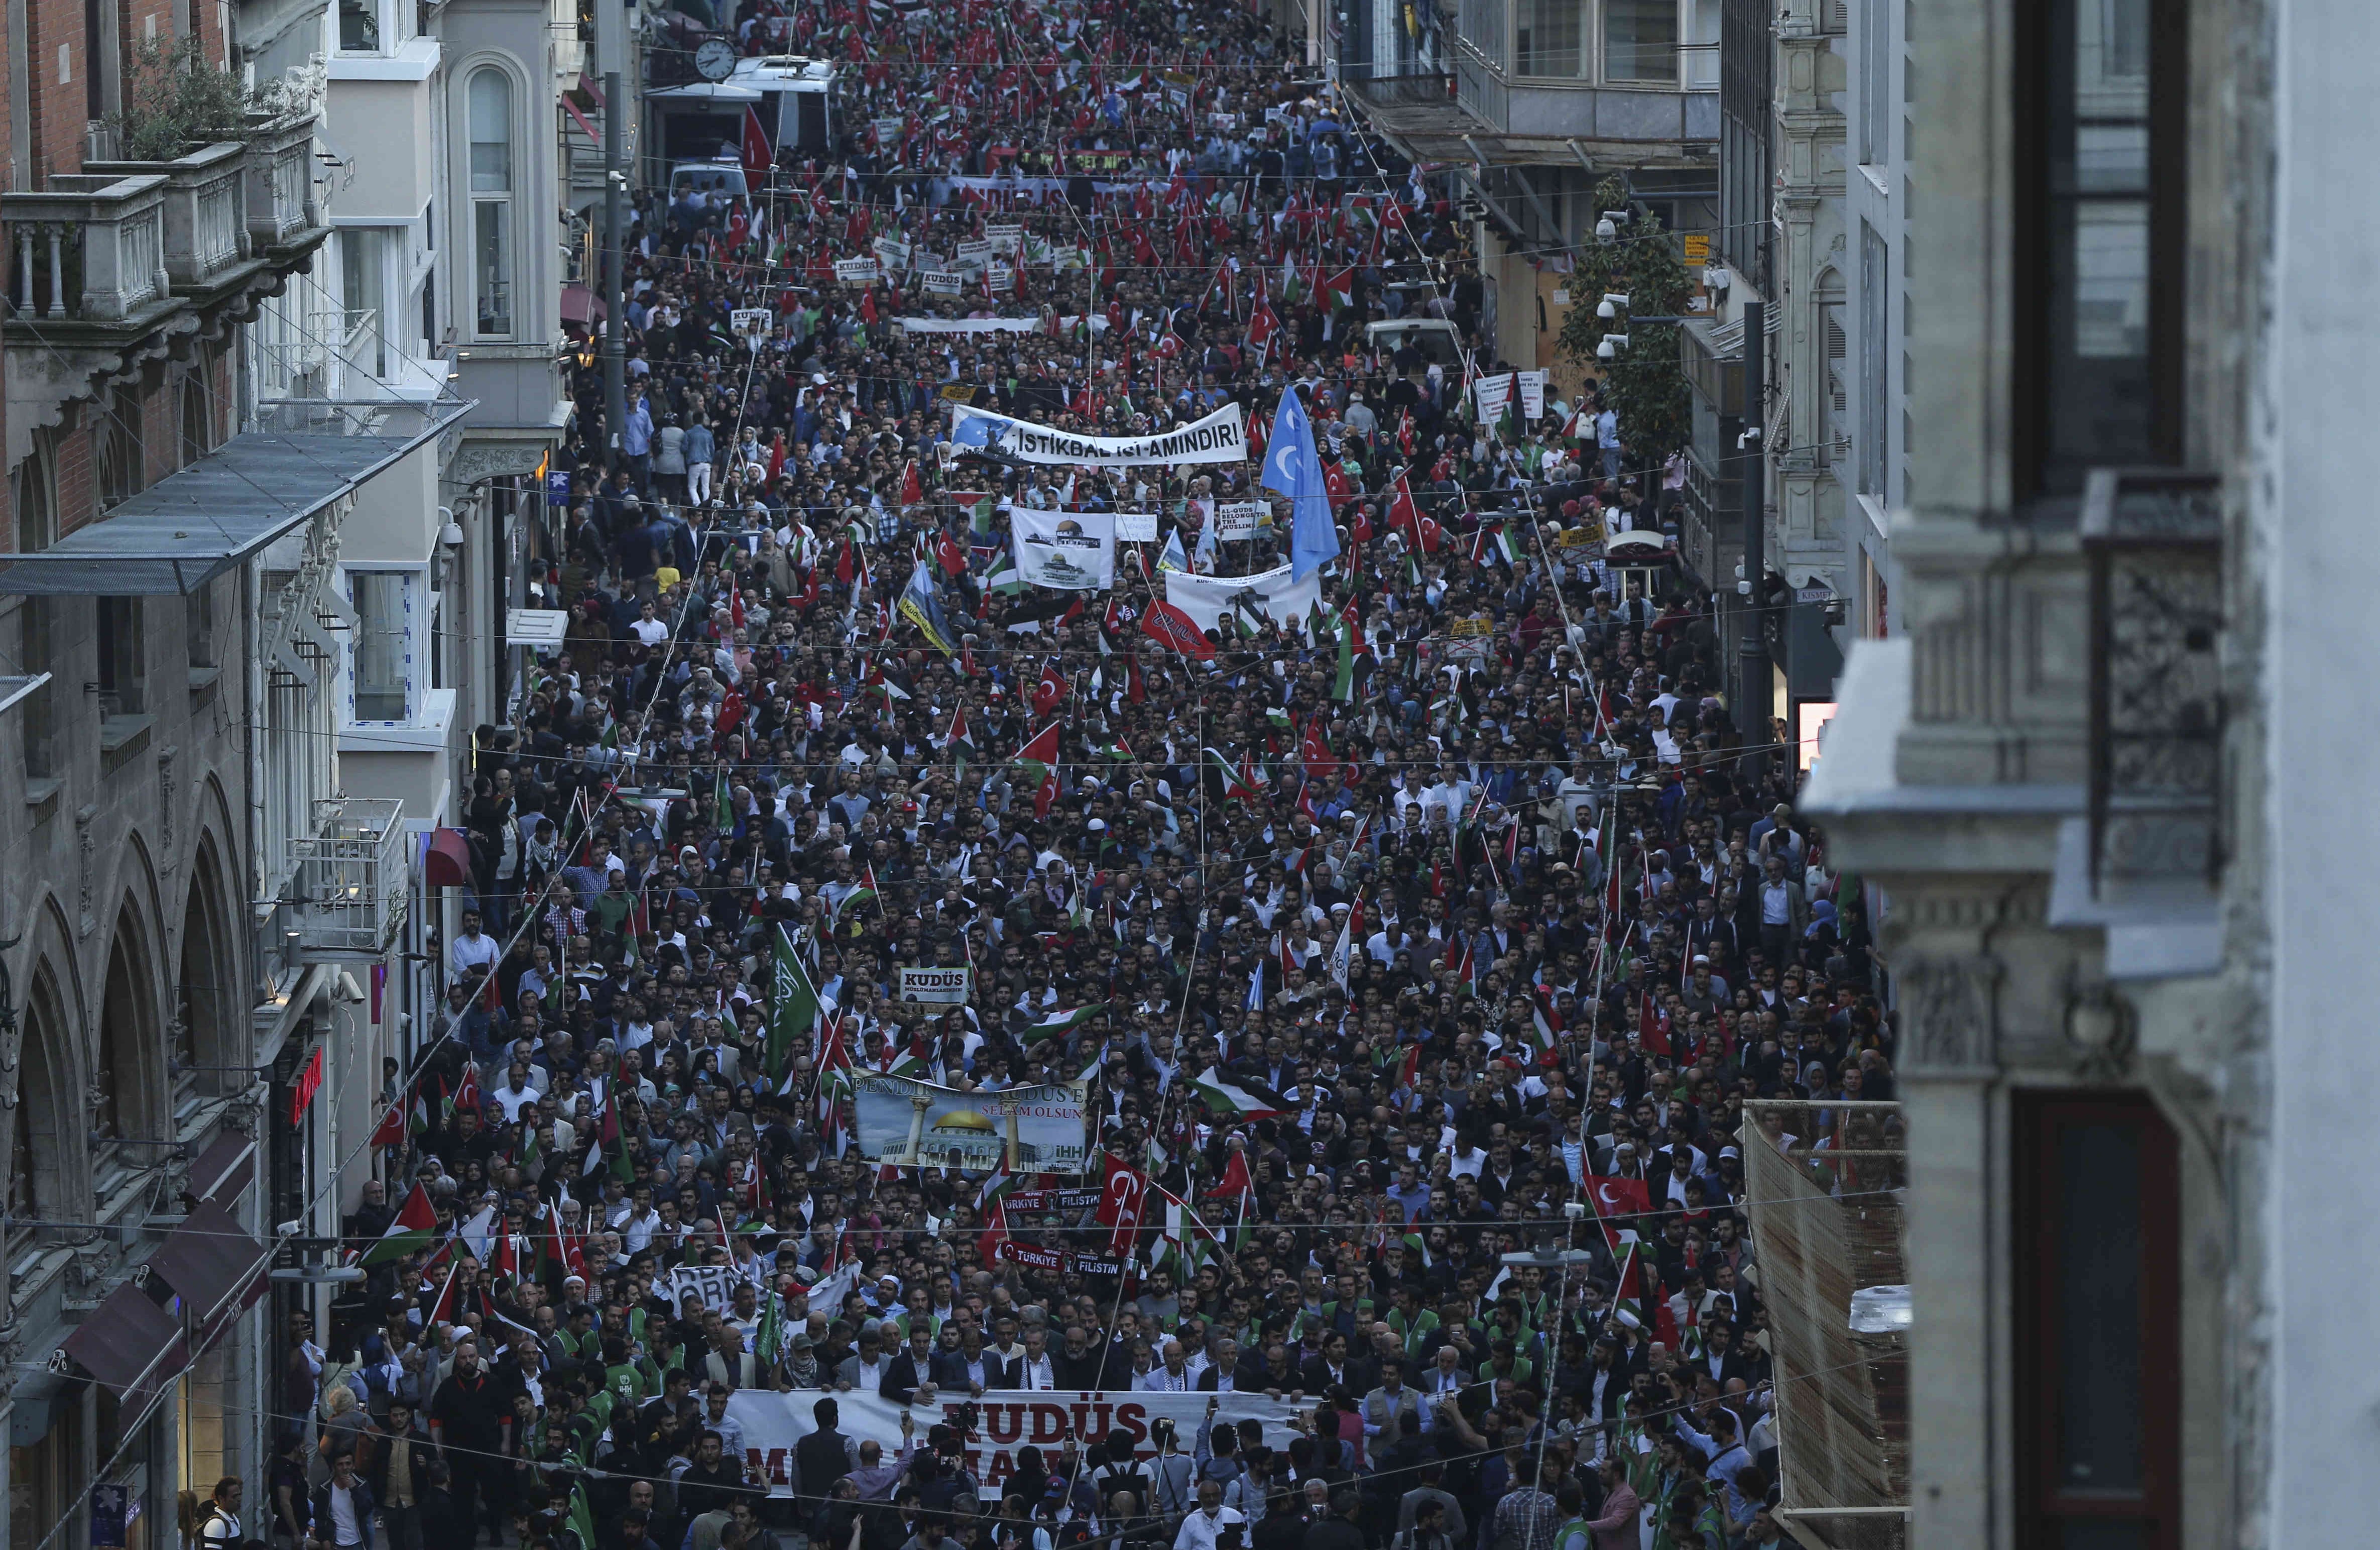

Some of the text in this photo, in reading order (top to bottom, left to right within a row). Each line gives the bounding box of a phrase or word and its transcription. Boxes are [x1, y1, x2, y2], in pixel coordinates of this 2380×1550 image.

[925, 274, 960, 283] KUDÜS
[905, 971, 963, 986] KUDÜS
[982, 1104, 1083, 1119] SELAM OLSUN
